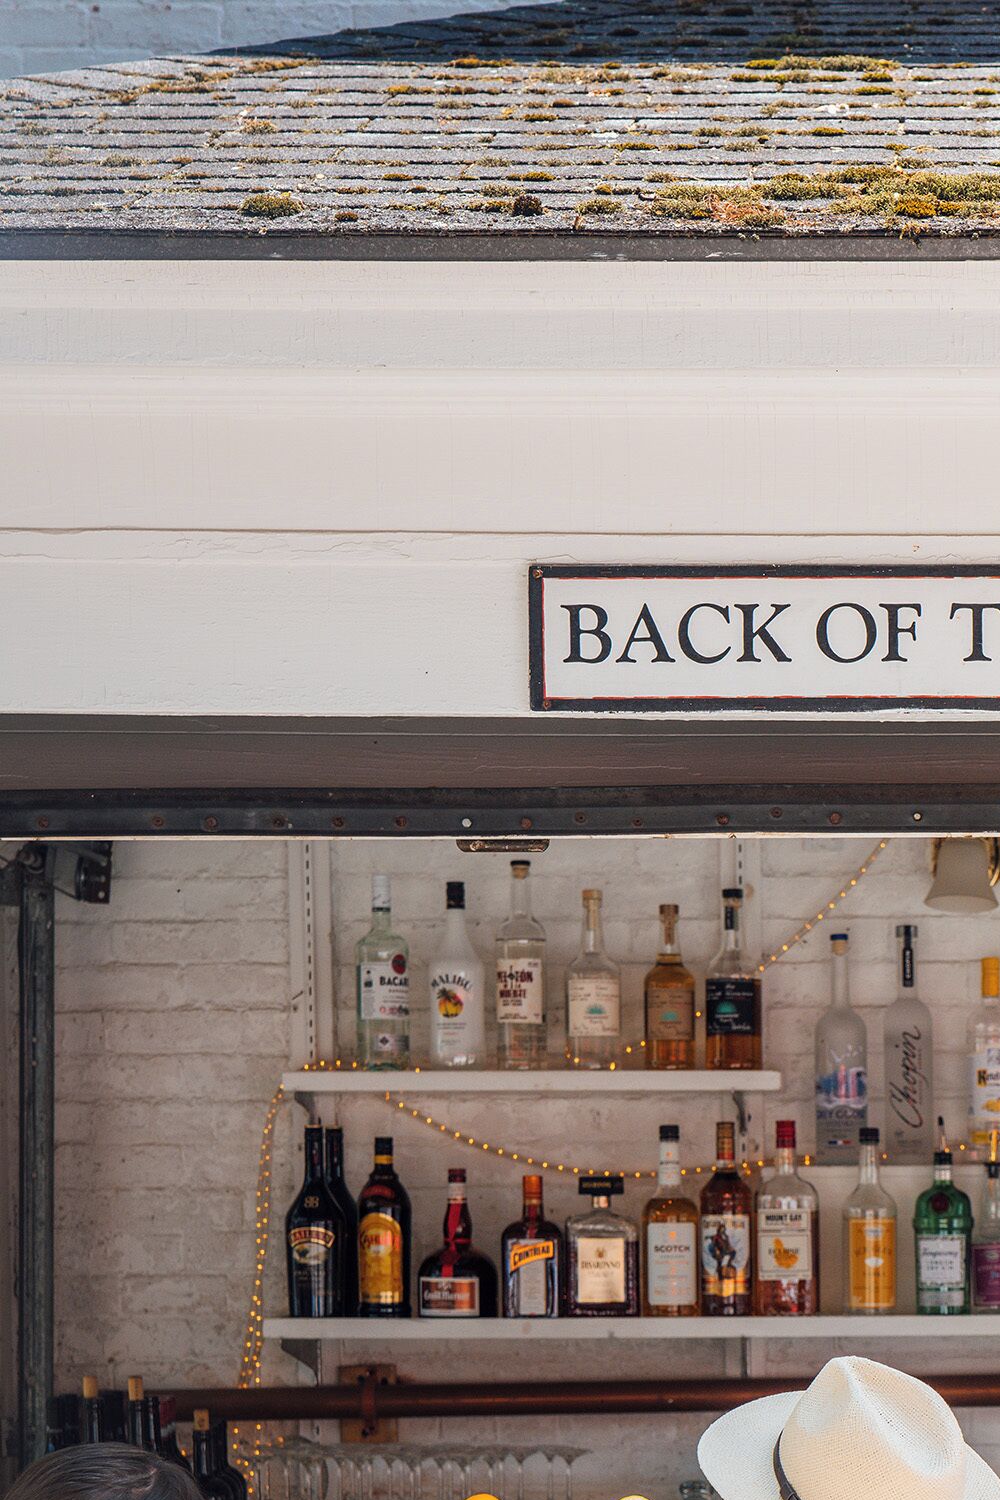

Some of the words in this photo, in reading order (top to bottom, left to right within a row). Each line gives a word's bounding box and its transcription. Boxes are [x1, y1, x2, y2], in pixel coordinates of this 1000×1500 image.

[561, 603, 792, 664] BACK
[817, 603, 921, 663] OF
[889, 1025, 929, 1128] Chopin
[654, 1245, 690, 1253] SCOTCH
